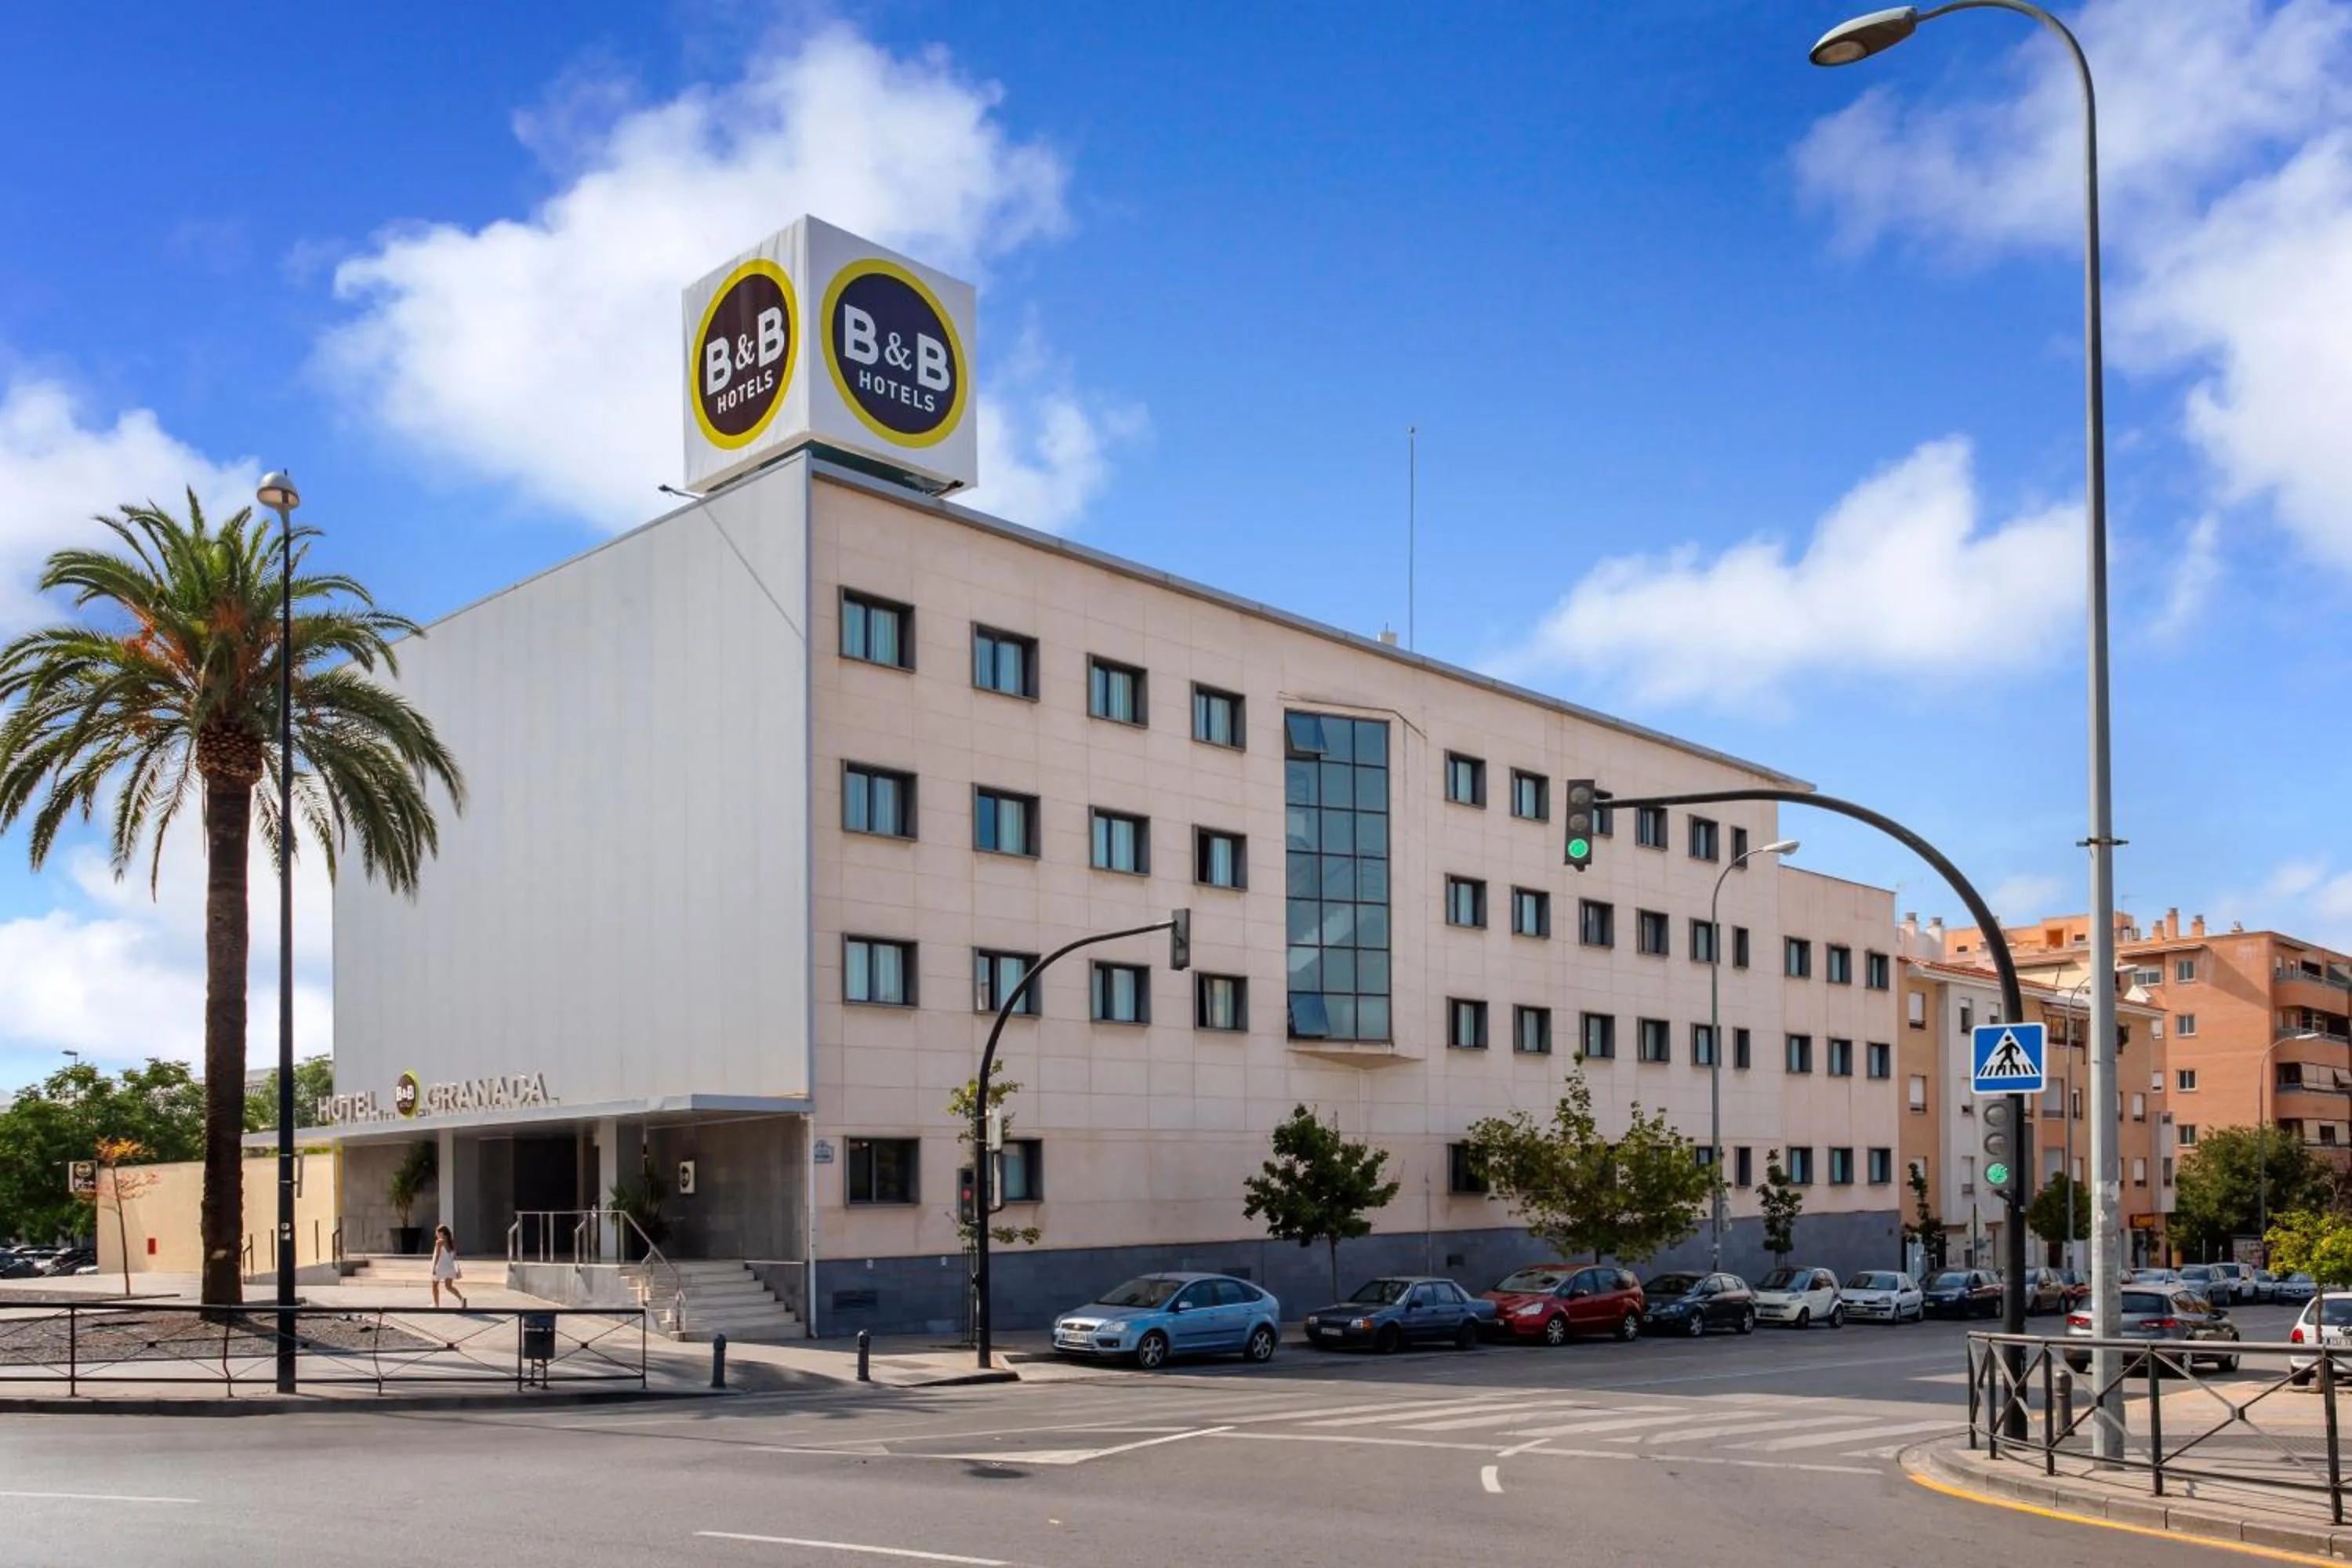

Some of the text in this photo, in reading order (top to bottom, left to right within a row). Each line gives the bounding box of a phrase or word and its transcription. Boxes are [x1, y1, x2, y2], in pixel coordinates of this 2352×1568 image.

[706, 307, 785, 396] B&B
[844, 303, 950, 392] B&B
[717, 369, 774, 414] HOTELS
[858, 369, 935, 412] HOTELS
[318, 1091, 377, 1121] HOTEL
[427, 1072, 550, 1111] GRANADA
